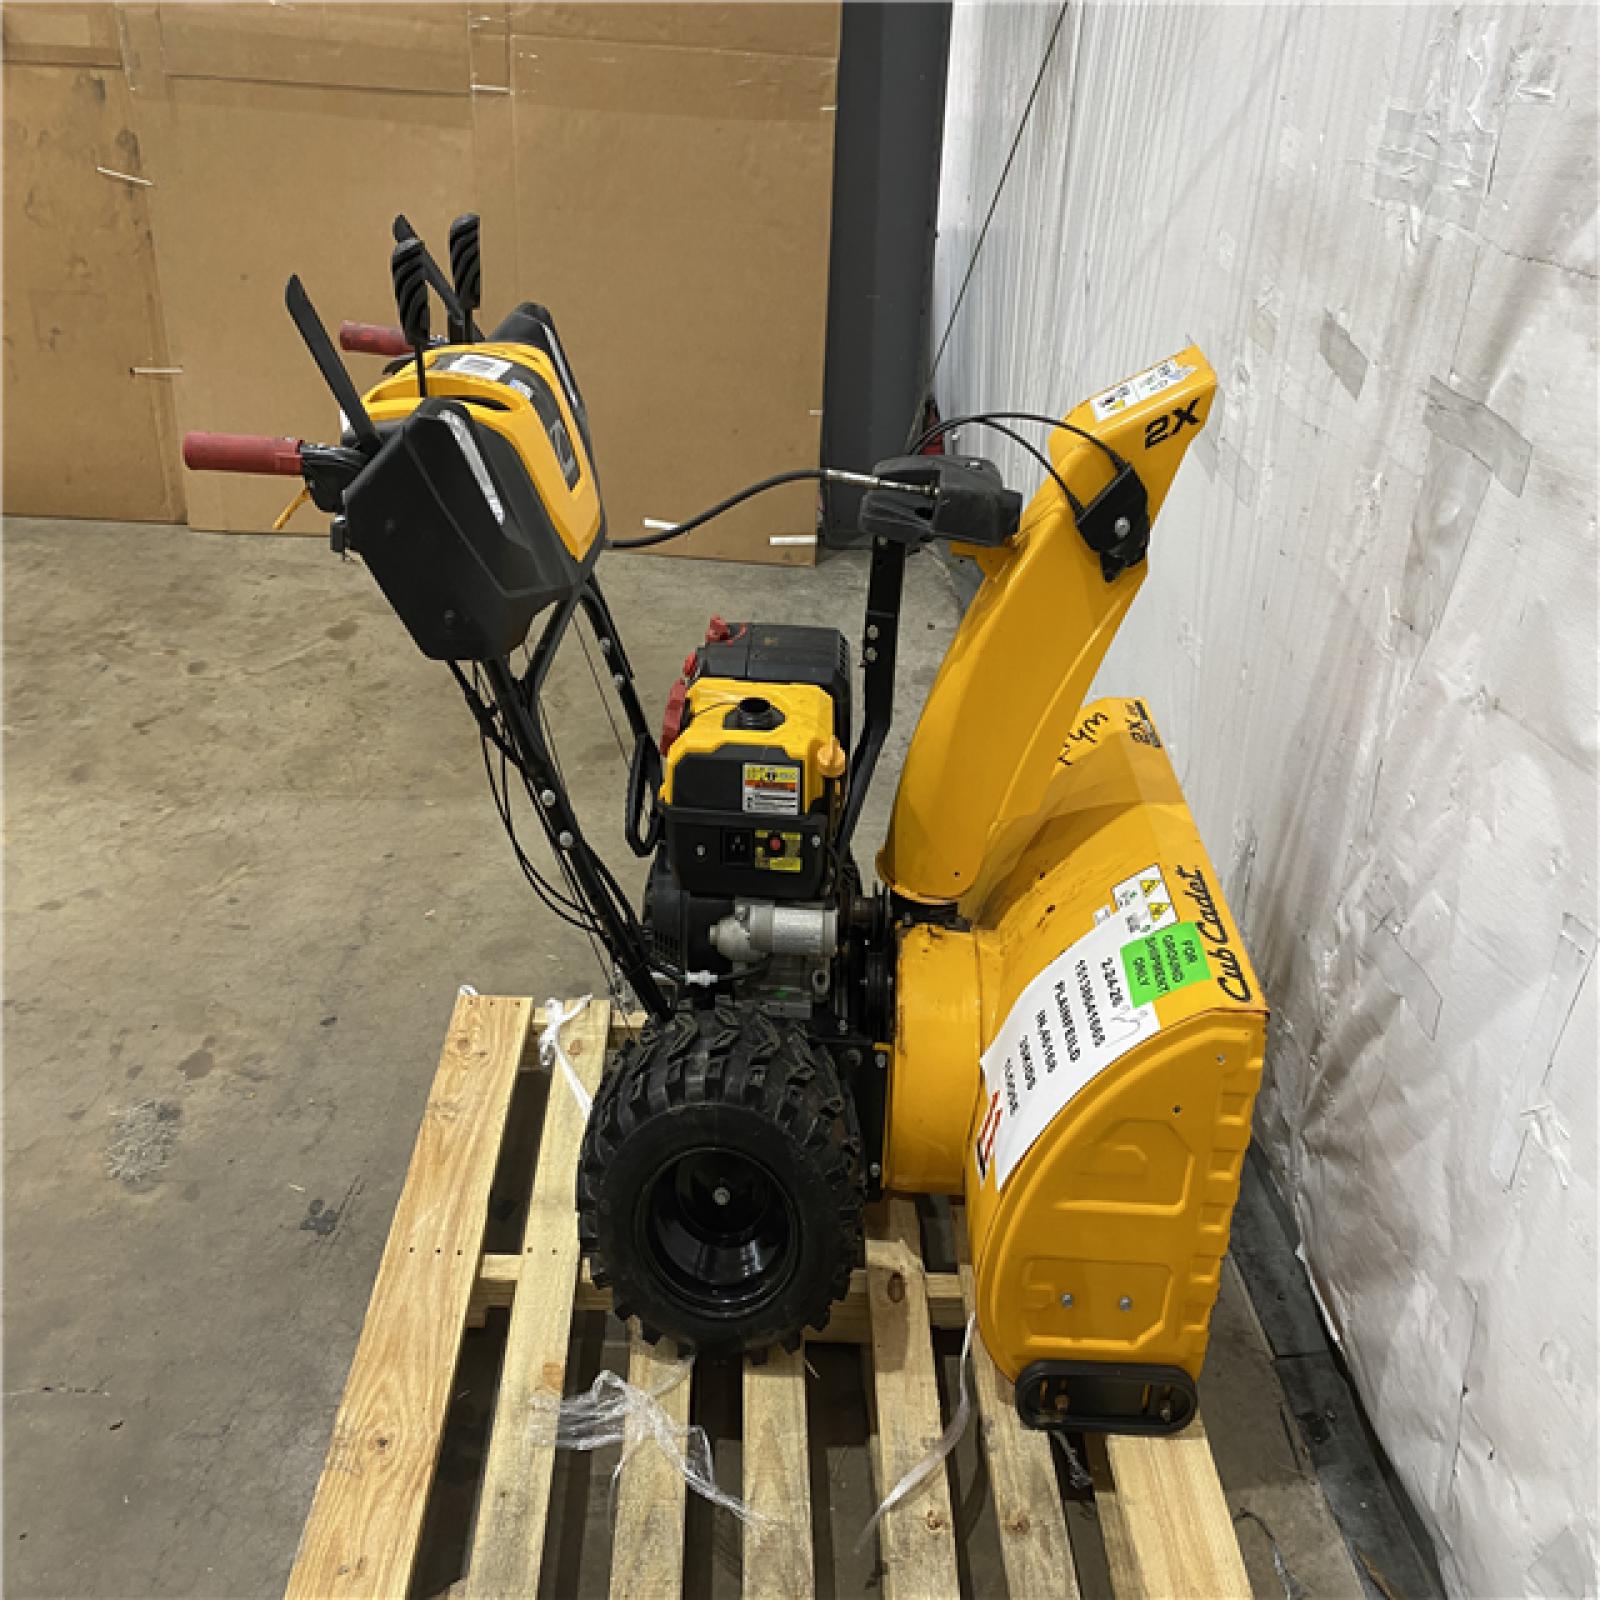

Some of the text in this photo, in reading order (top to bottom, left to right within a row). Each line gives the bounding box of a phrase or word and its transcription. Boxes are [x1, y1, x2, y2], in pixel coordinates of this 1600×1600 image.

[1144, 398, 1200, 450] 2X
[1162, 934, 1184, 984] GROUND
[1176, 864, 1251, 1003] Cub Cadet
[1181, 939, 1198, 965] FOR
[1132, 957, 1151, 986] ONLY
[1145, 937, 1171, 993] SHIPMENT
